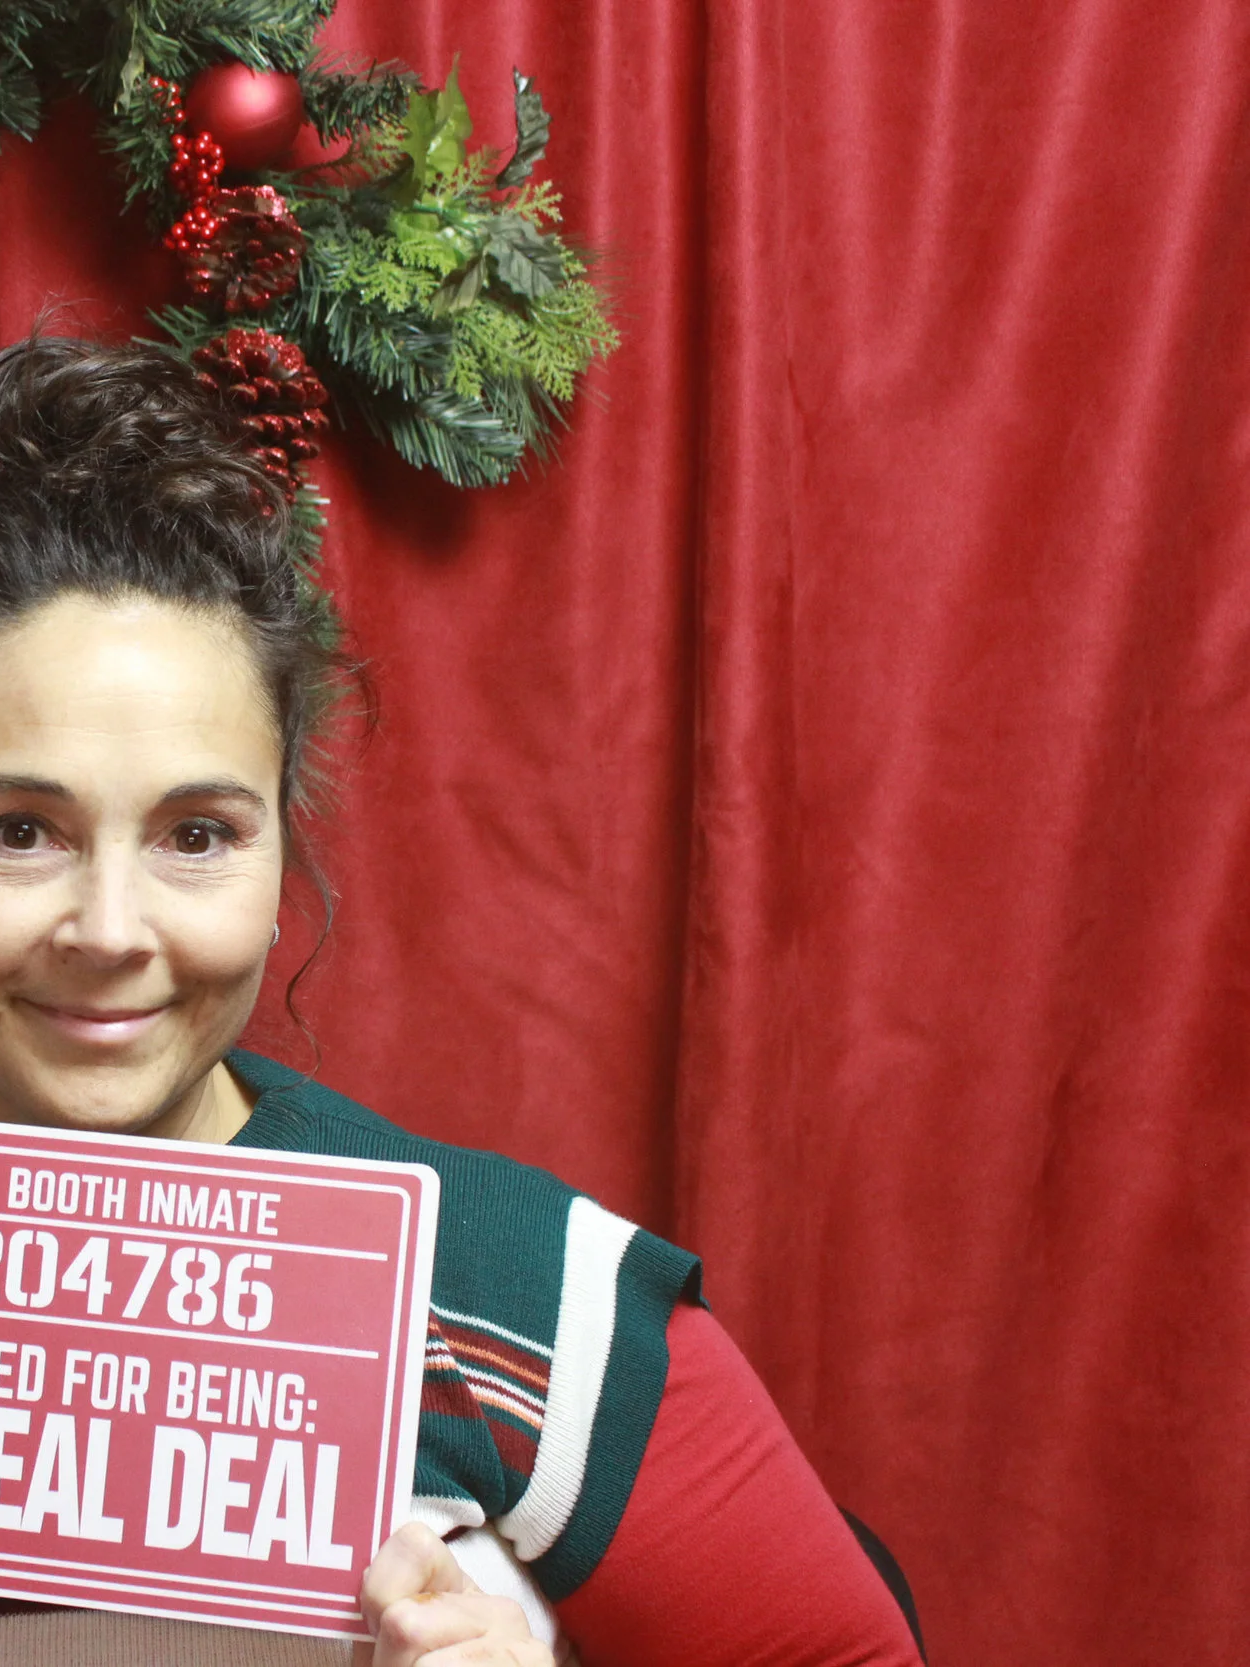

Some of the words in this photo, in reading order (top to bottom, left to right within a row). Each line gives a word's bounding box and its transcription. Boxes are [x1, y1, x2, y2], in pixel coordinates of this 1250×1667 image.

[7, 1166, 127, 1221] BOOTH
[139, 1179, 282, 1237] INMATE
[61, 1348, 151, 1415] FOR
[166, 1360, 318, 1435] BEING:
[144, 1424, 354, 1572] DEAL
